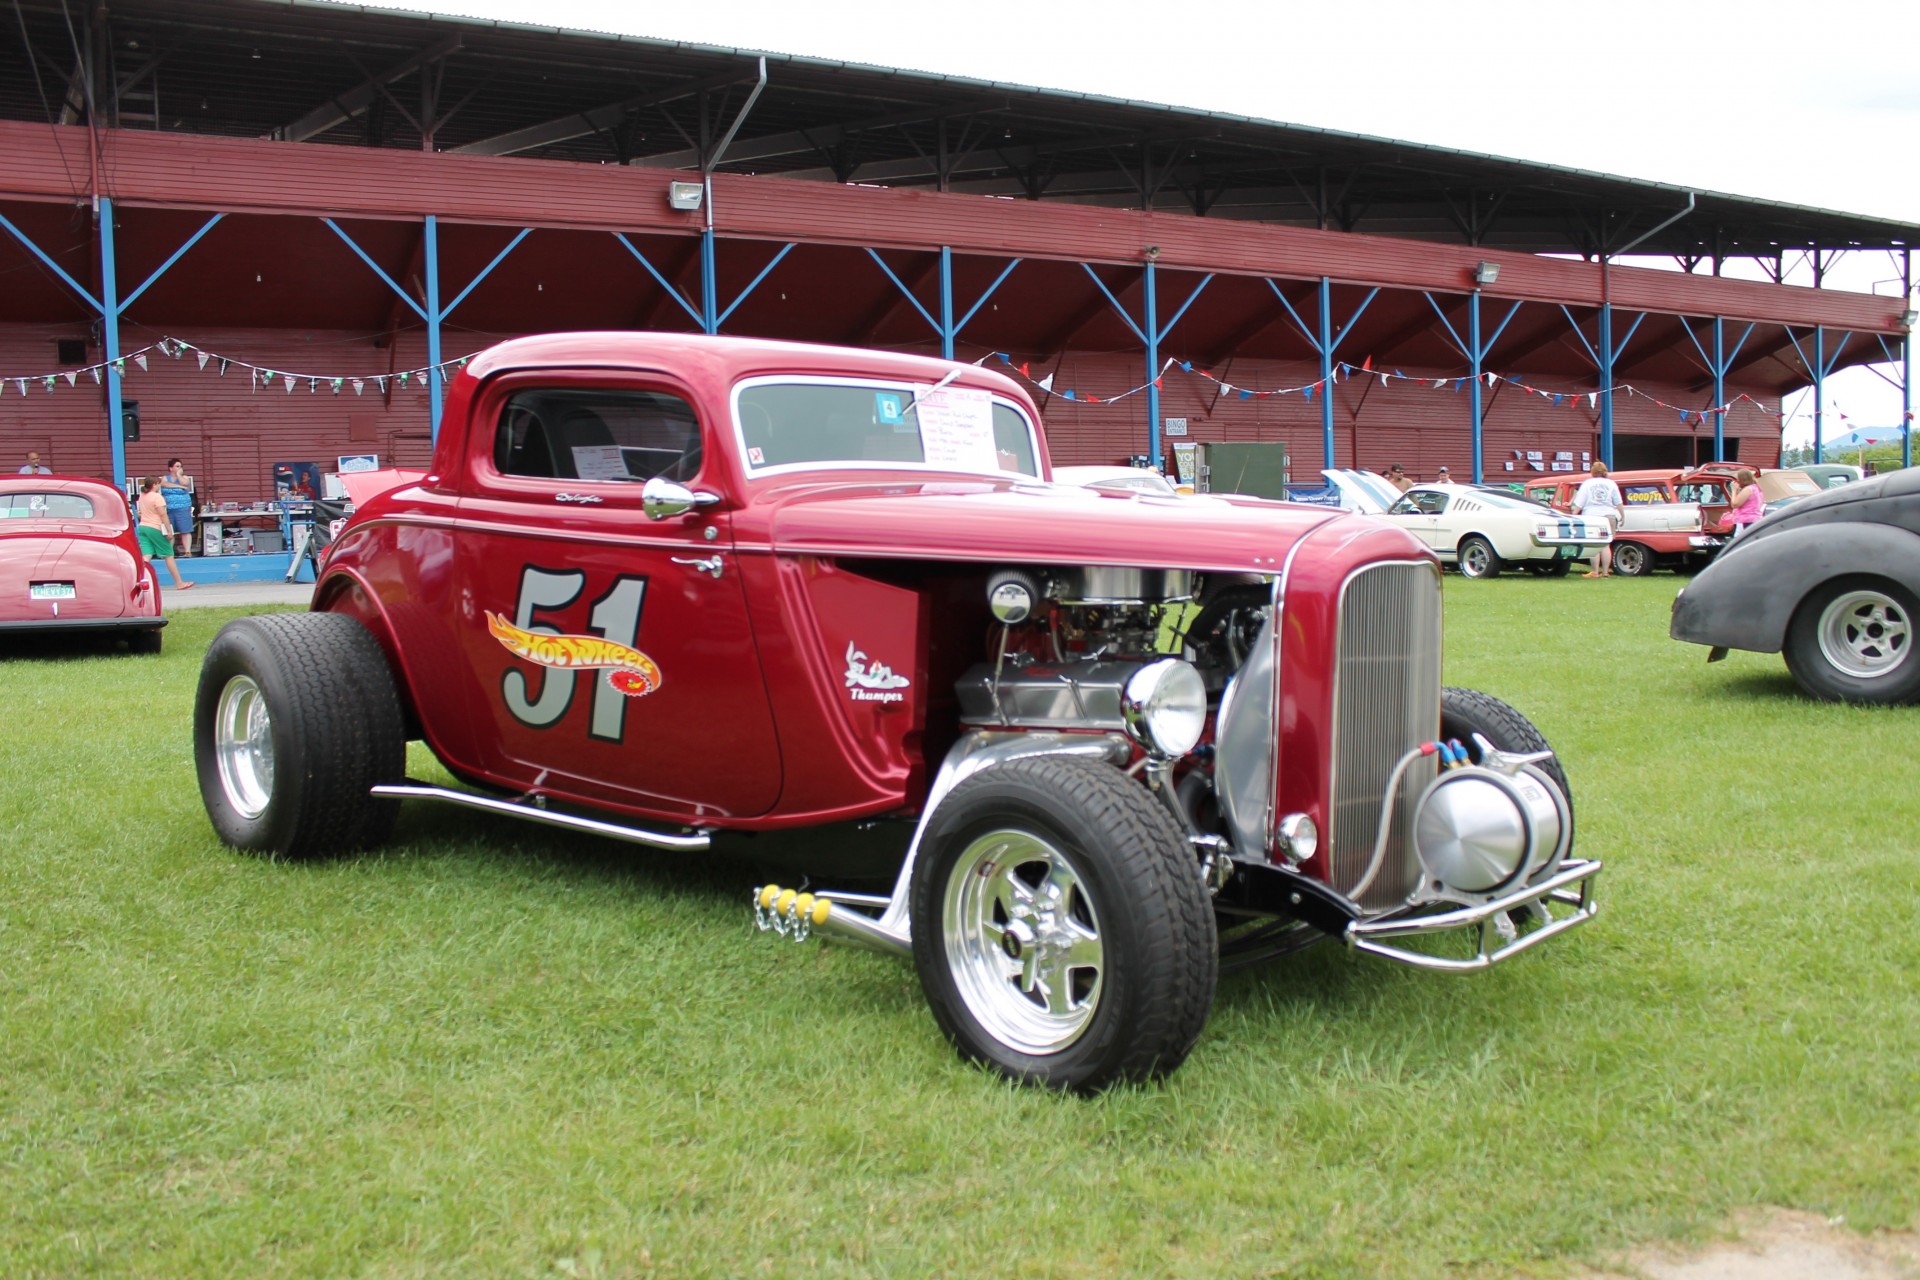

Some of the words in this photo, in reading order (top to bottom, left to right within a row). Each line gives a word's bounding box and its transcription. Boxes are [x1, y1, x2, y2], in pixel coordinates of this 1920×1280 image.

[1167, 419, 1185, 429] BINGO
[502, 562, 649, 745] 51
[849, 688, 904, 704] Thumper
